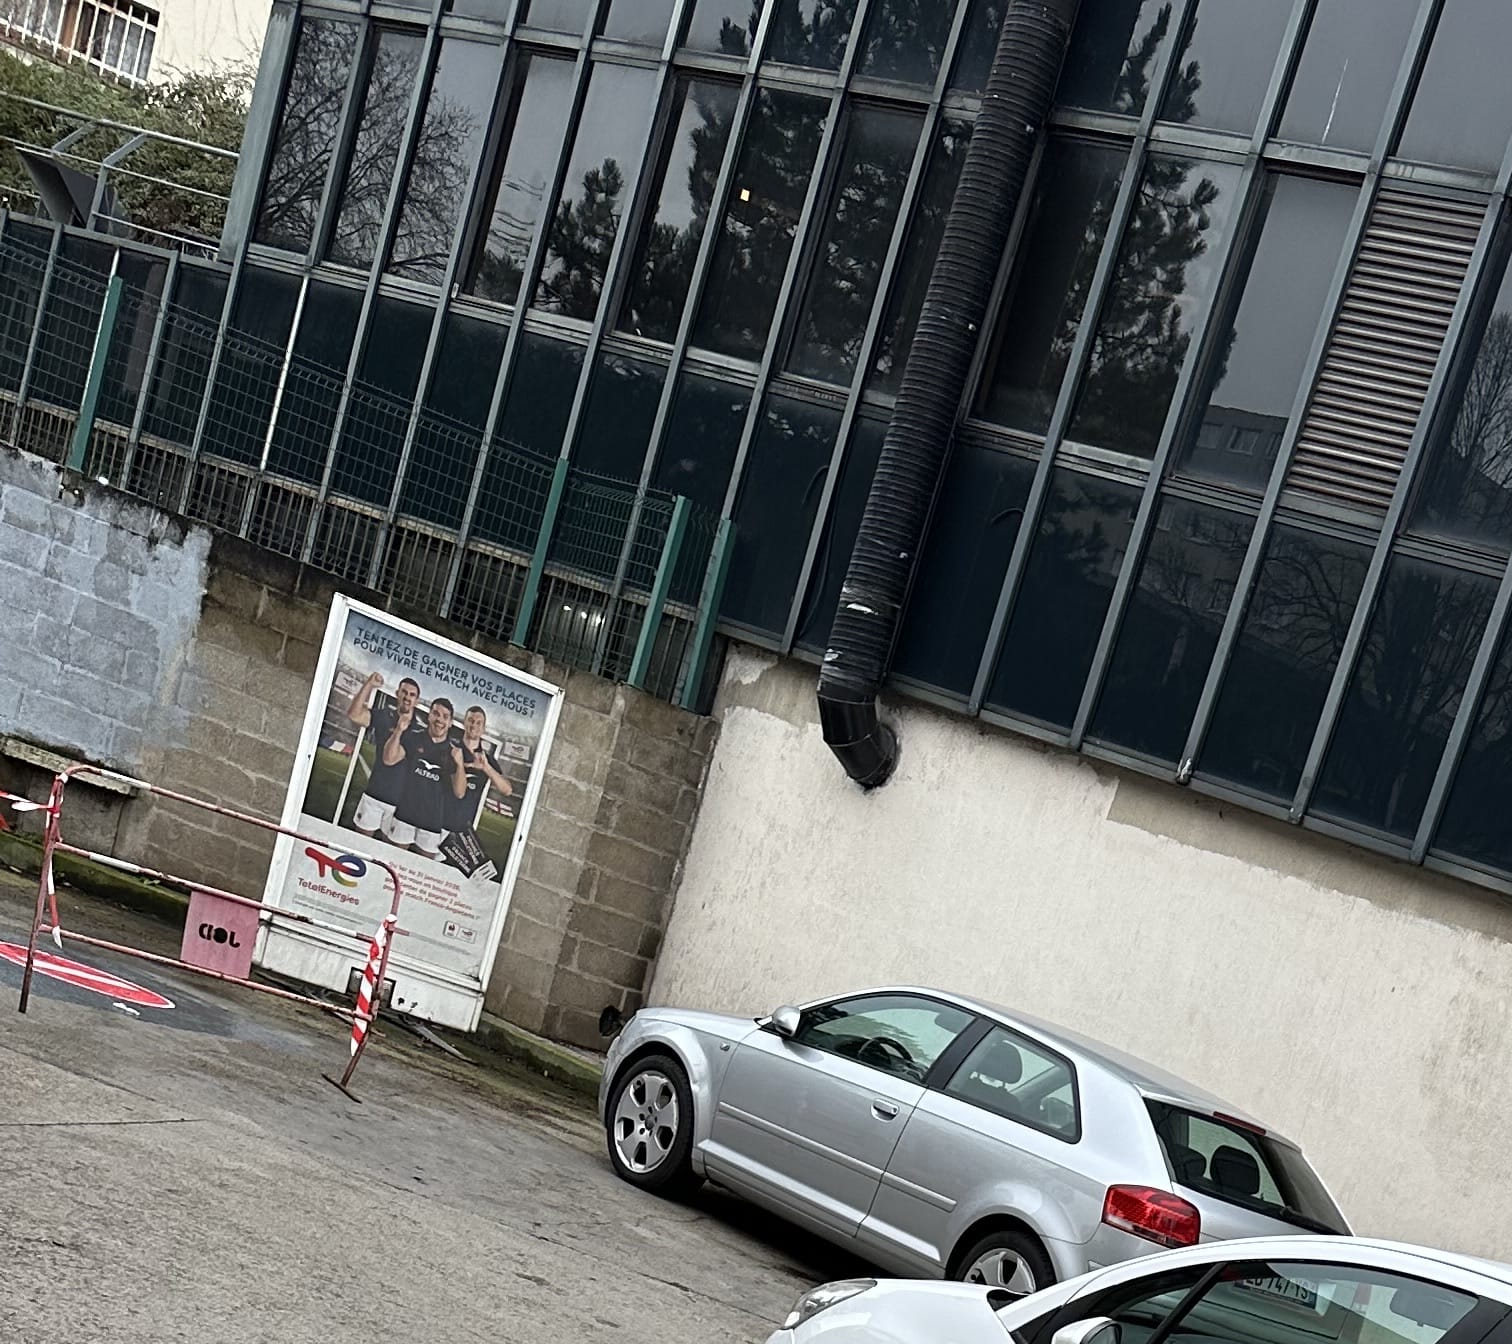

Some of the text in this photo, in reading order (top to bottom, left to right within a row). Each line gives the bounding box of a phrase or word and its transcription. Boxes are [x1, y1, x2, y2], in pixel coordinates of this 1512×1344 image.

[353, 638, 385, 658] POUR
[386, 652, 417, 670] VIVRE
[420, 664, 432, 677] LE
[435, 671, 470, 692] MATCH
[472, 687, 499, 704] AVEC
[500, 698, 528, 715] NOUS
[357, 628, 536, 708] TENTEZ DE GAGNER VOS PLACES
[298, 877, 360, 905] TotalEnergies
